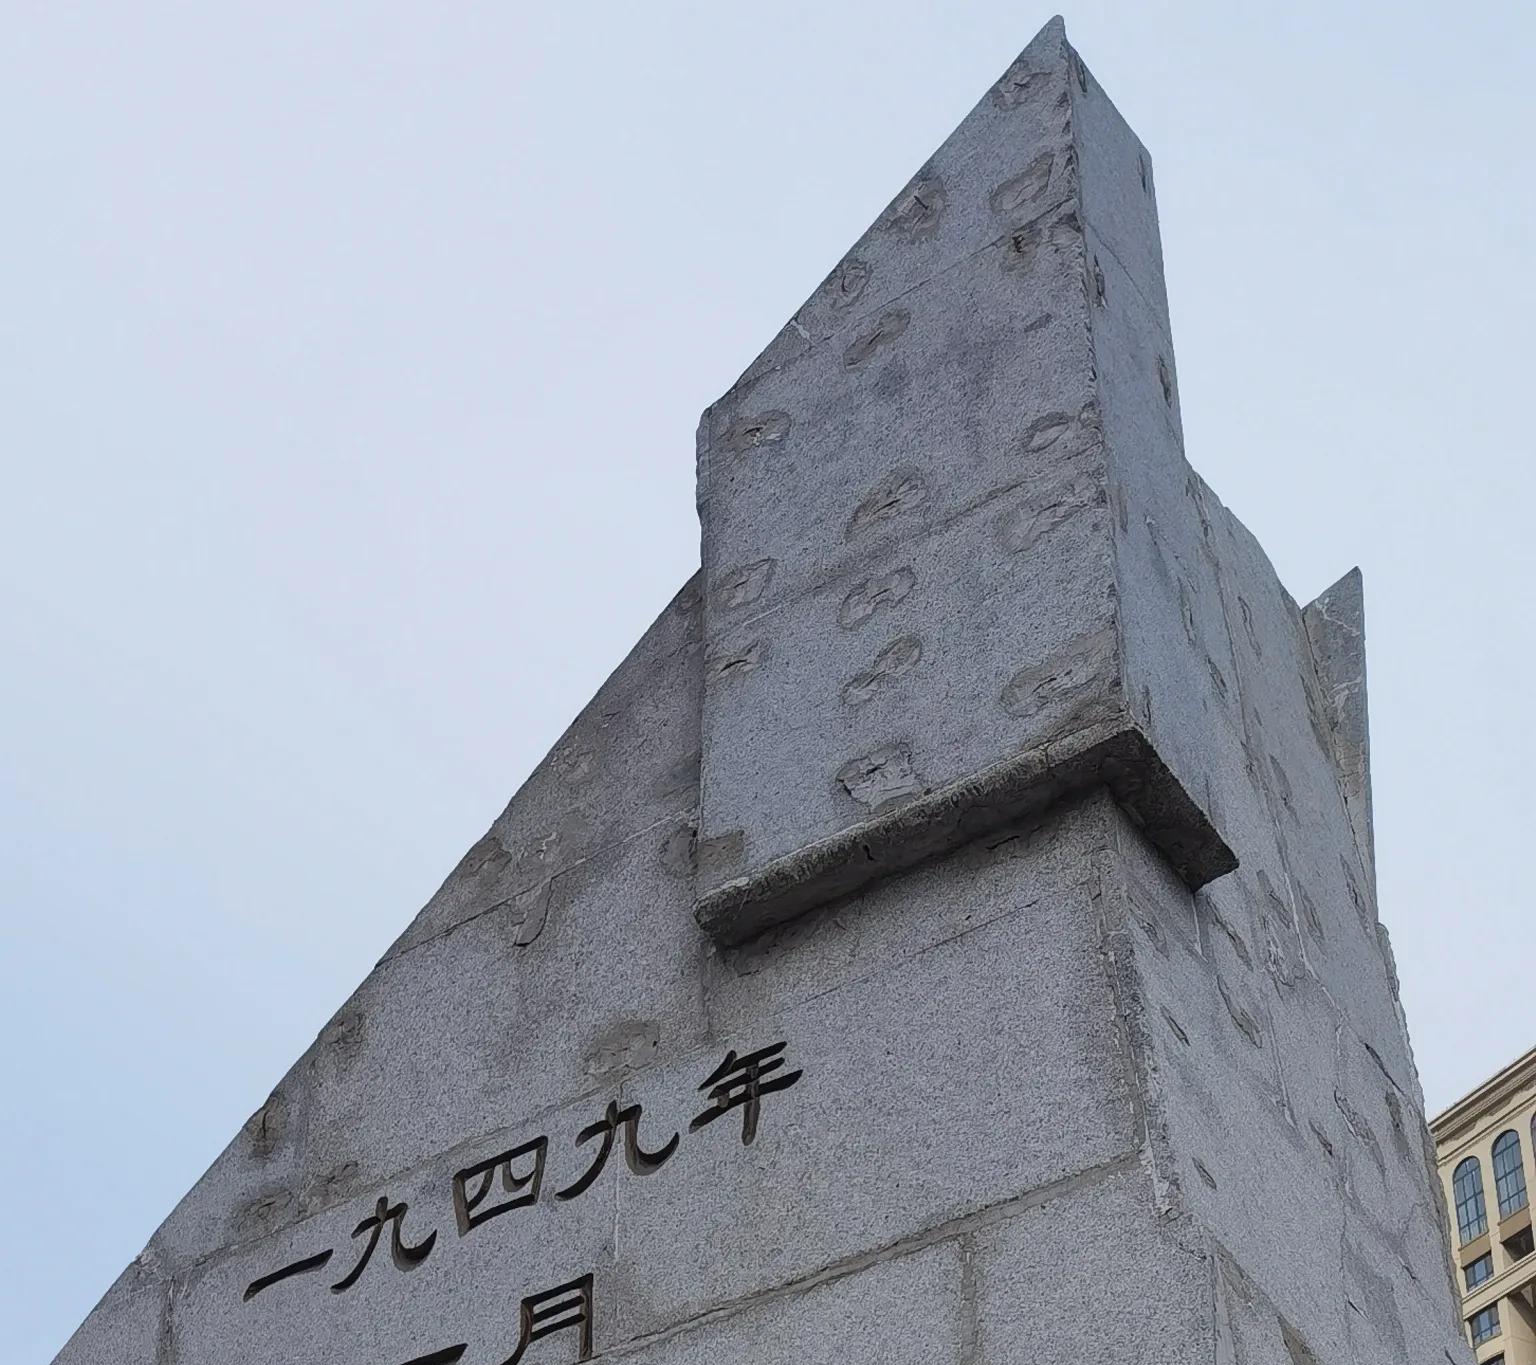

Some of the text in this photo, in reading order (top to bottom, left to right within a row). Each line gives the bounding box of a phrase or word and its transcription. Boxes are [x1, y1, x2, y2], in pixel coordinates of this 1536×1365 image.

[243, 1041, 803, 1302] 一九四九年
